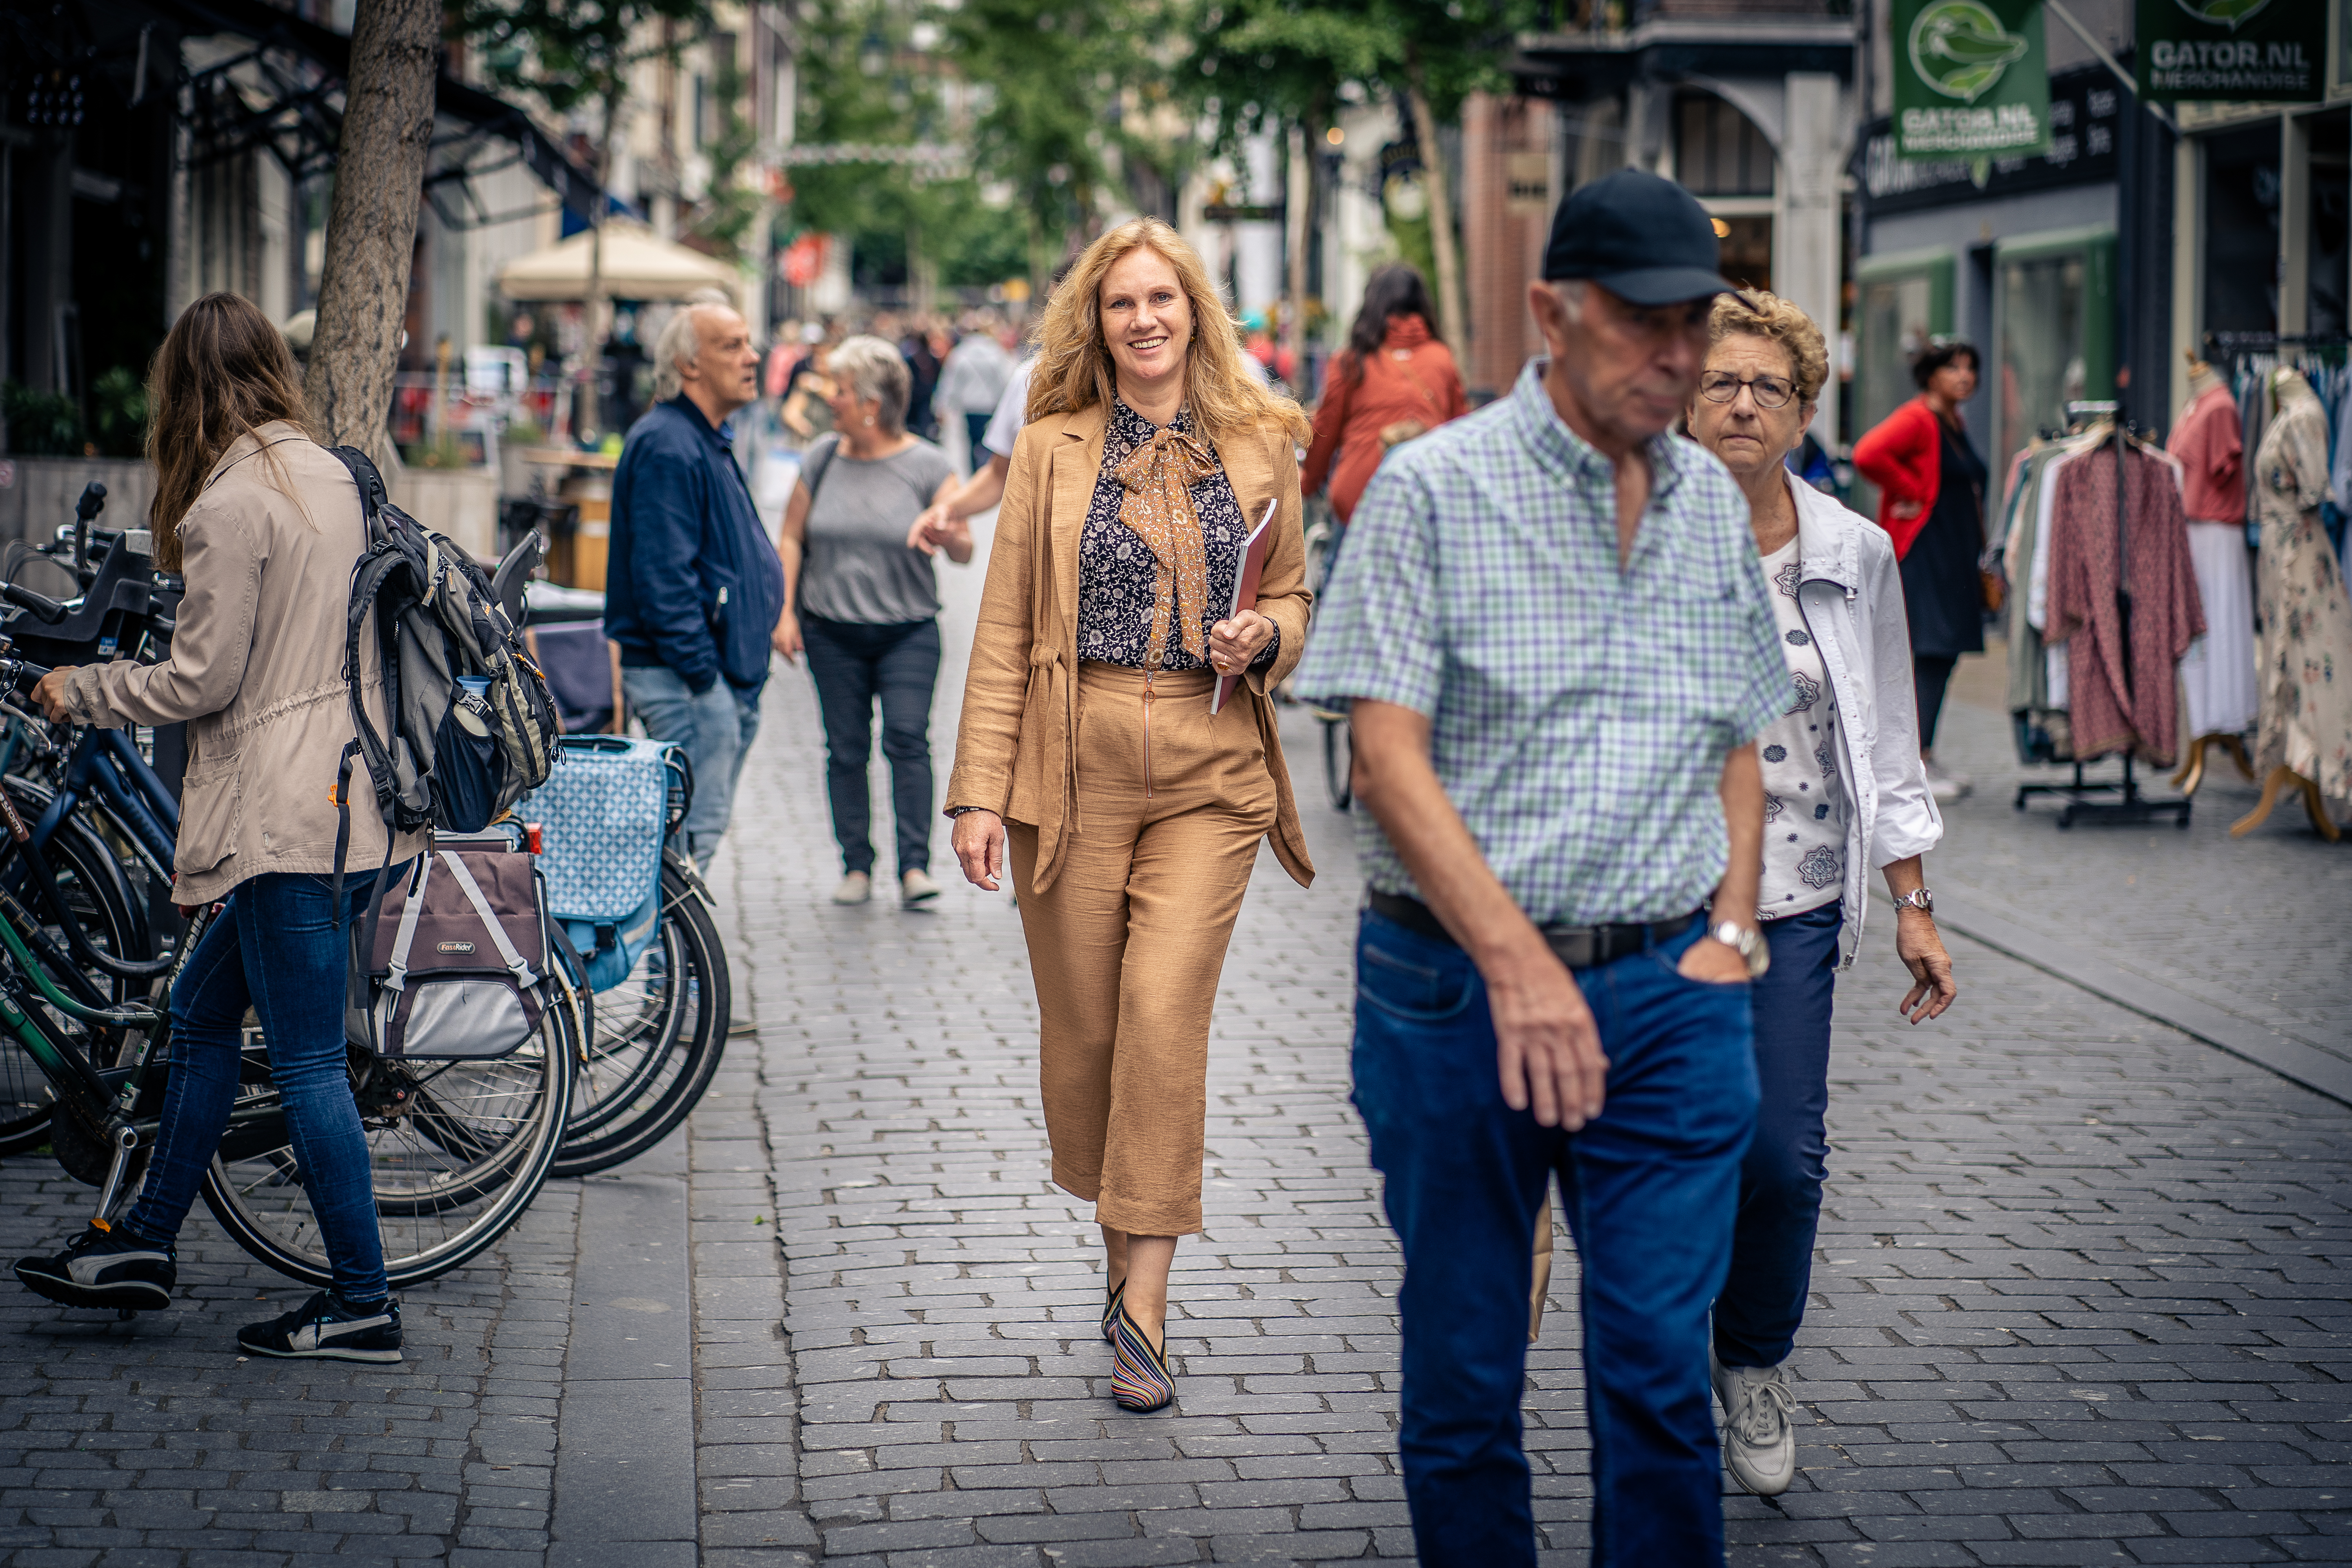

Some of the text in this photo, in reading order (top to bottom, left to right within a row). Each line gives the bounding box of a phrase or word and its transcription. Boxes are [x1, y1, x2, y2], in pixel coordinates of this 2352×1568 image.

[2151, 41, 2311, 70] GATOR.NL
[2150, 68, 2311, 90] MERCHANDISE
[1902, 103, 2038, 132] GATOR.NL
[1902, 130, 2038, 151] MERCHANDISE
